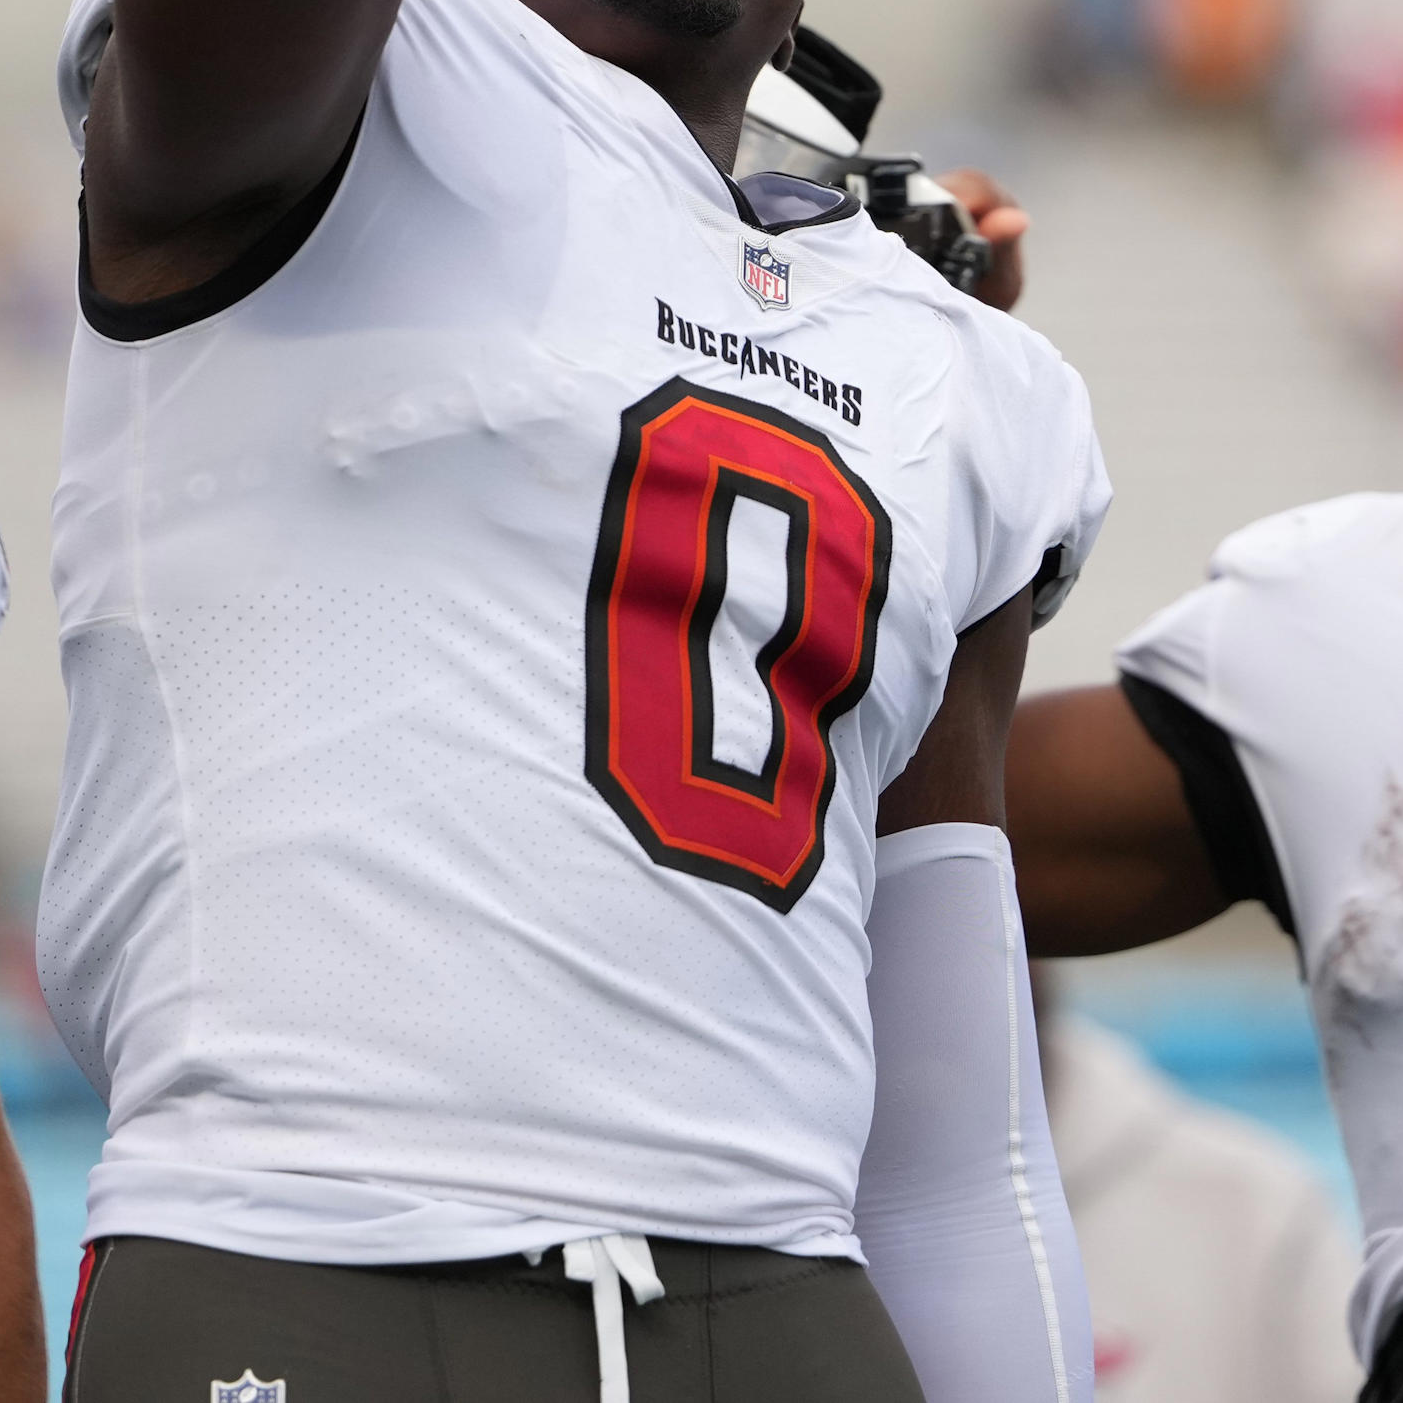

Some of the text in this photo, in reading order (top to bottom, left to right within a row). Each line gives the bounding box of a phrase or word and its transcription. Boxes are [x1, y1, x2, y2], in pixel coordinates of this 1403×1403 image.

[747, 262, 785, 300] NFL
[655, 296, 862, 427] BUCCANEERS
[585, 376, 893, 916] 0
